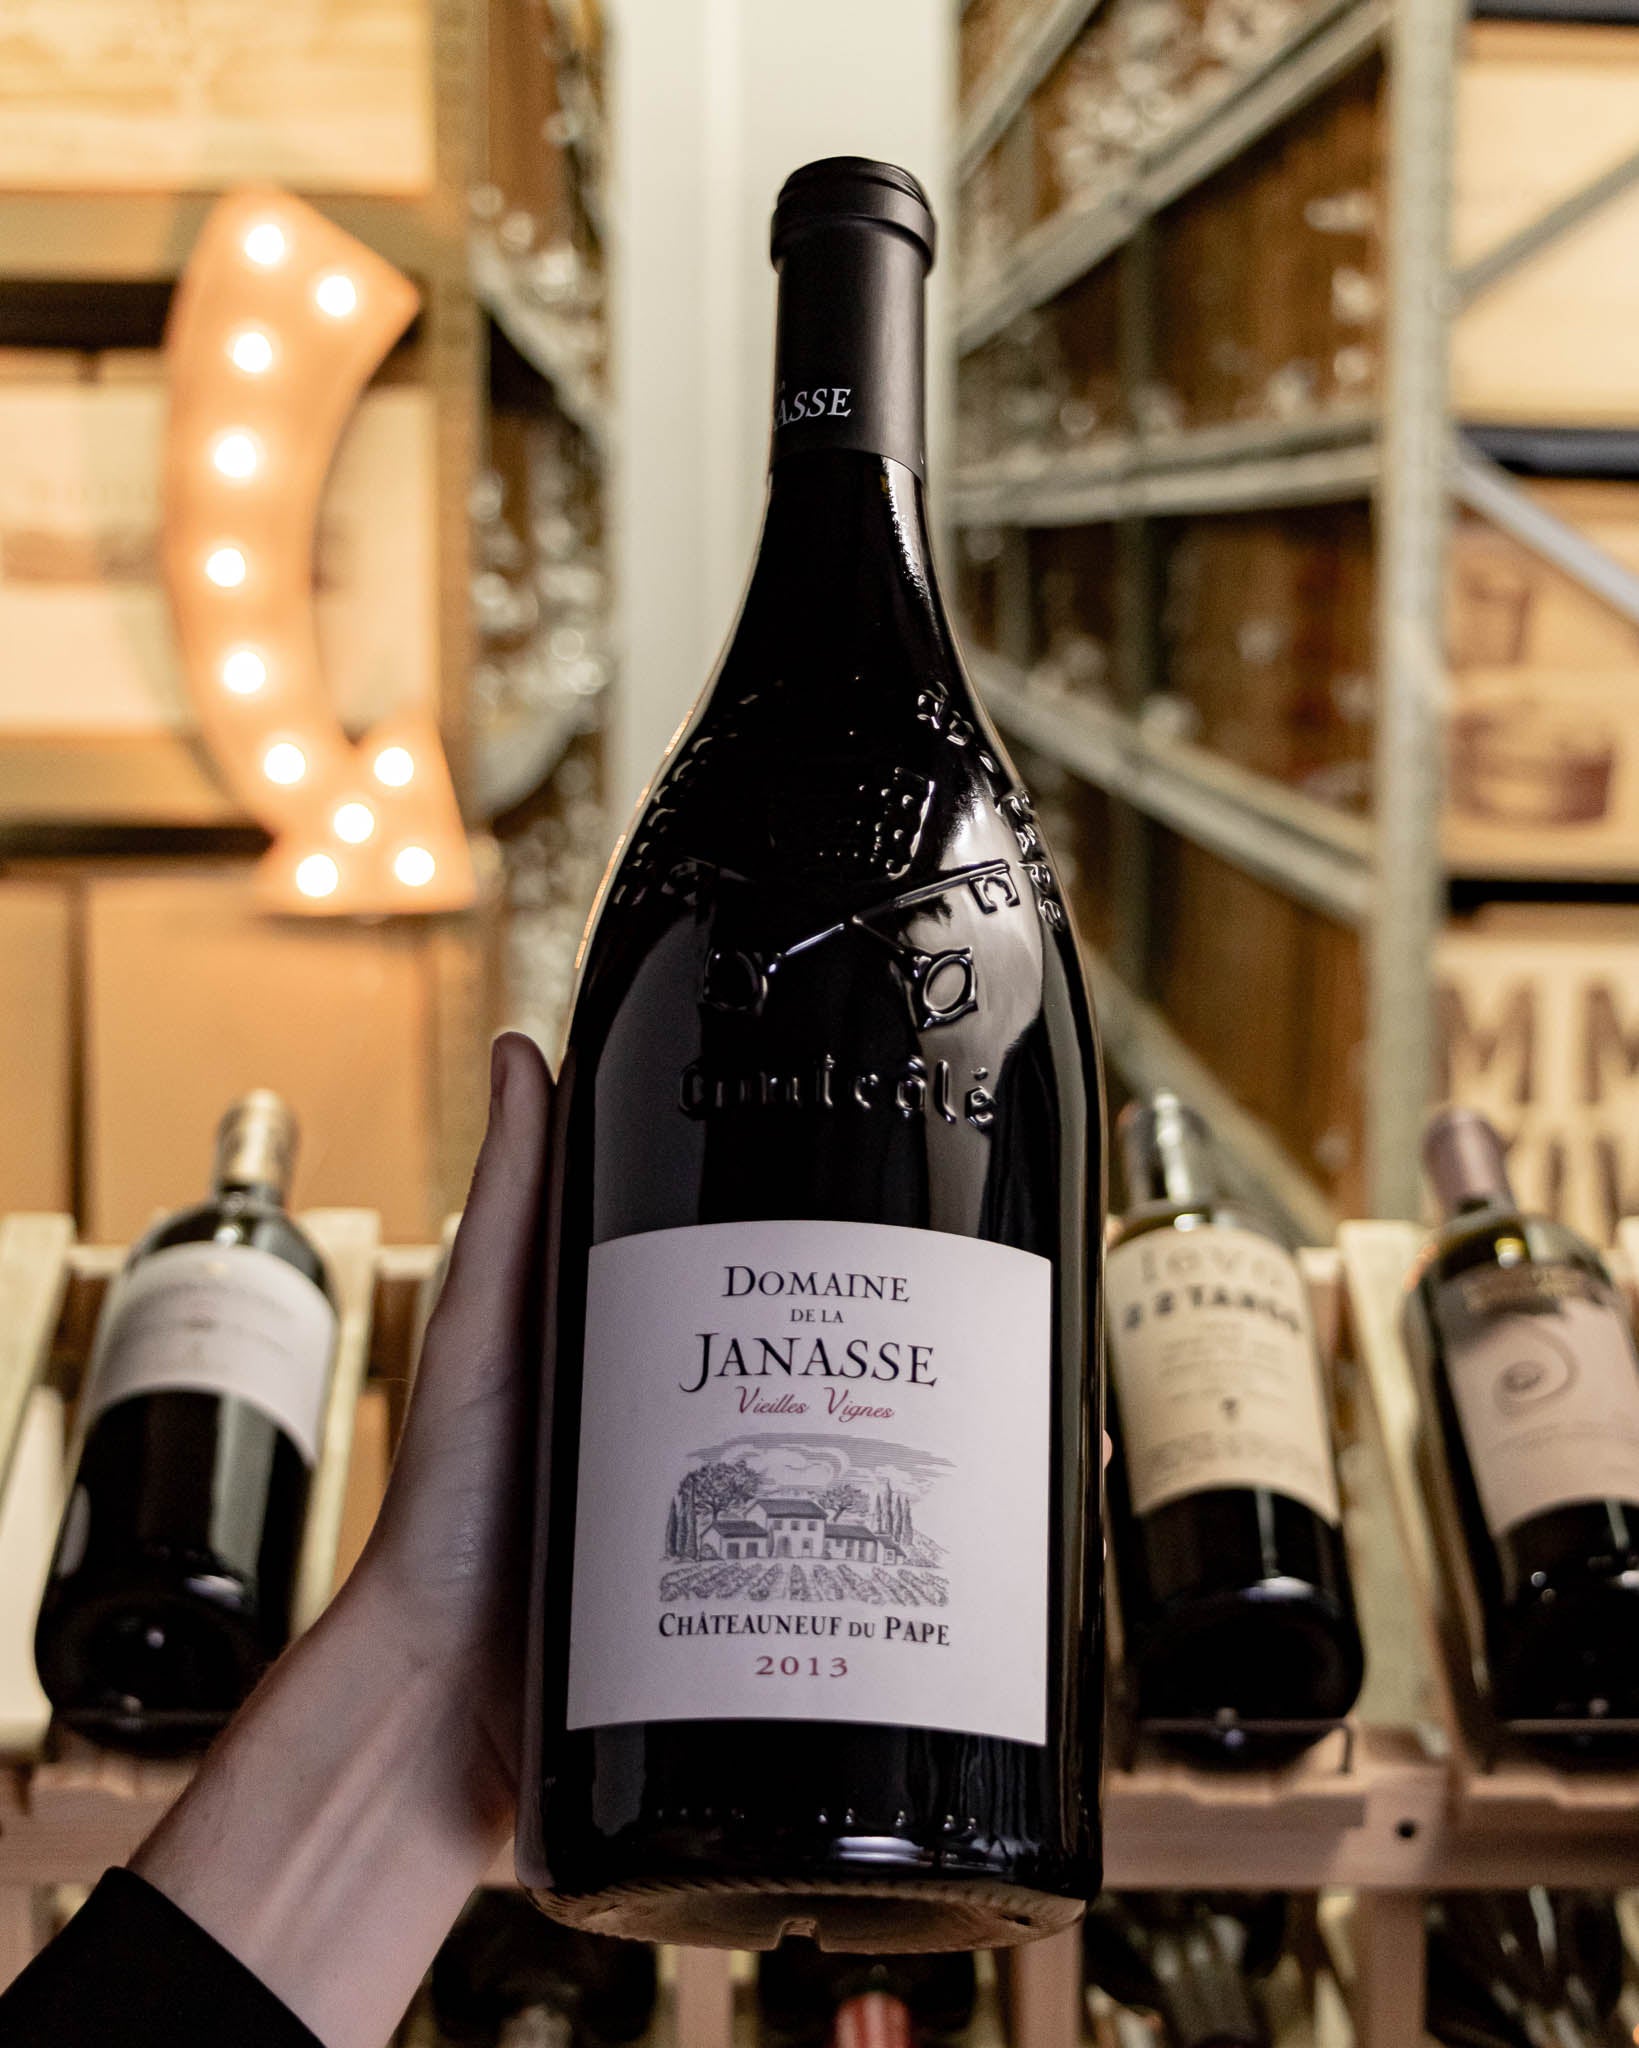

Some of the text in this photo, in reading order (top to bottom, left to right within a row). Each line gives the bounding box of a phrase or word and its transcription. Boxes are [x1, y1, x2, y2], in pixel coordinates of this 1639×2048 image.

[721, 1265, 910, 1303] DOMAINE
[790, 1308, 844, 1324] DE LA
[678, 1332, 938, 1393] JANASSE
[735, 1385, 896, 1423] Vieilles Vignes
[658, 1611, 951, 1647] CHÂTEAUNEUF DU PAPE
[755, 1655, 849, 1678] 2013
